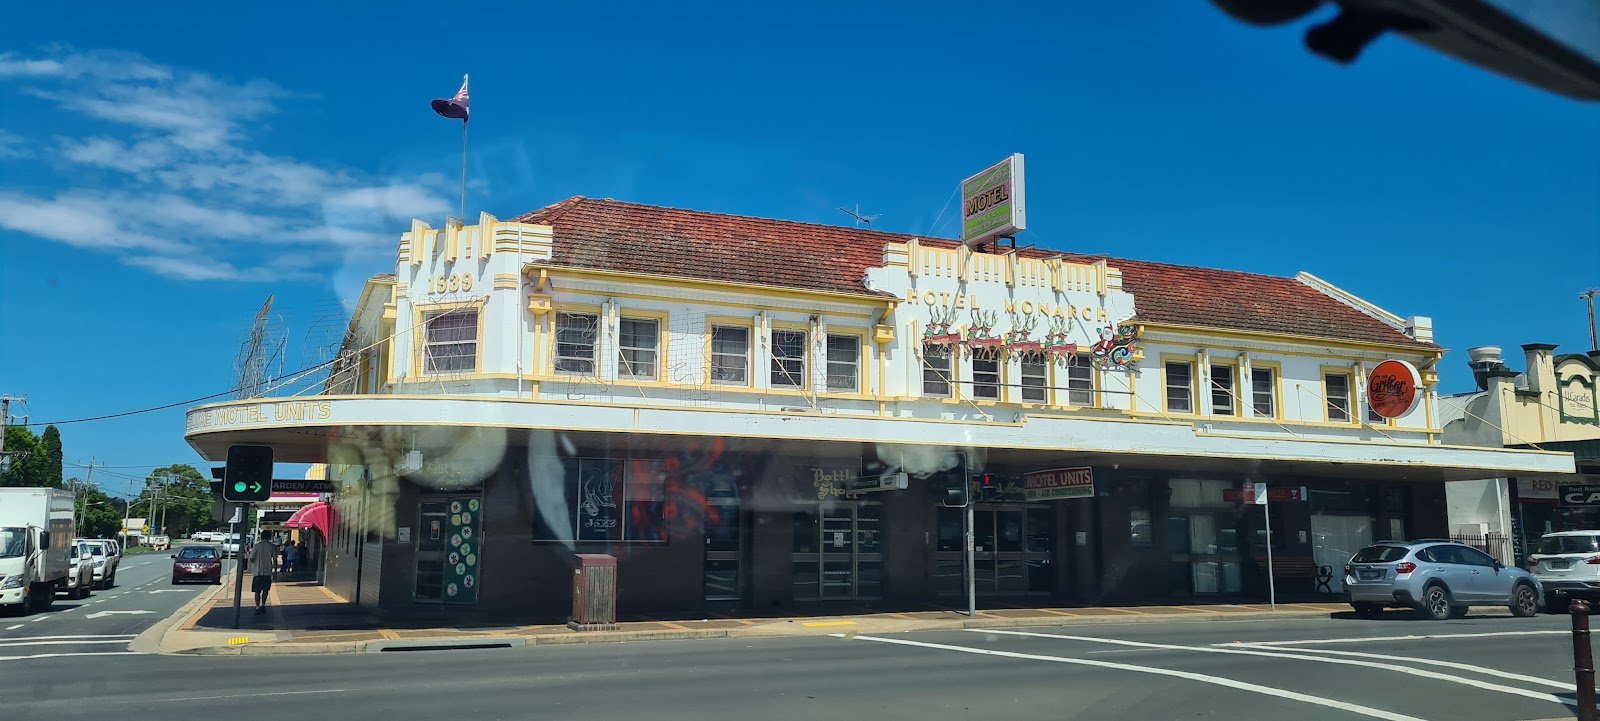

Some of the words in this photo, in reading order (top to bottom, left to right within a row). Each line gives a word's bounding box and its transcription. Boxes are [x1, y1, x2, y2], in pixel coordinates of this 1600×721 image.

[965, 185, 1009, 217] MOTEL
[427, 272, 474, 295] 1939
[907, 288, 980, 310] HOTEL
[1004, 298, 1107, 322] MONARCH
[215, 404, 268, 426] MOTEL
[274, 402, 332, 421] UNITS
[1025, 474, 1058, 488] MOTEL
[1060, 470, 1091, 486] UNITS
[1532, 479, 1553, 491] RED
